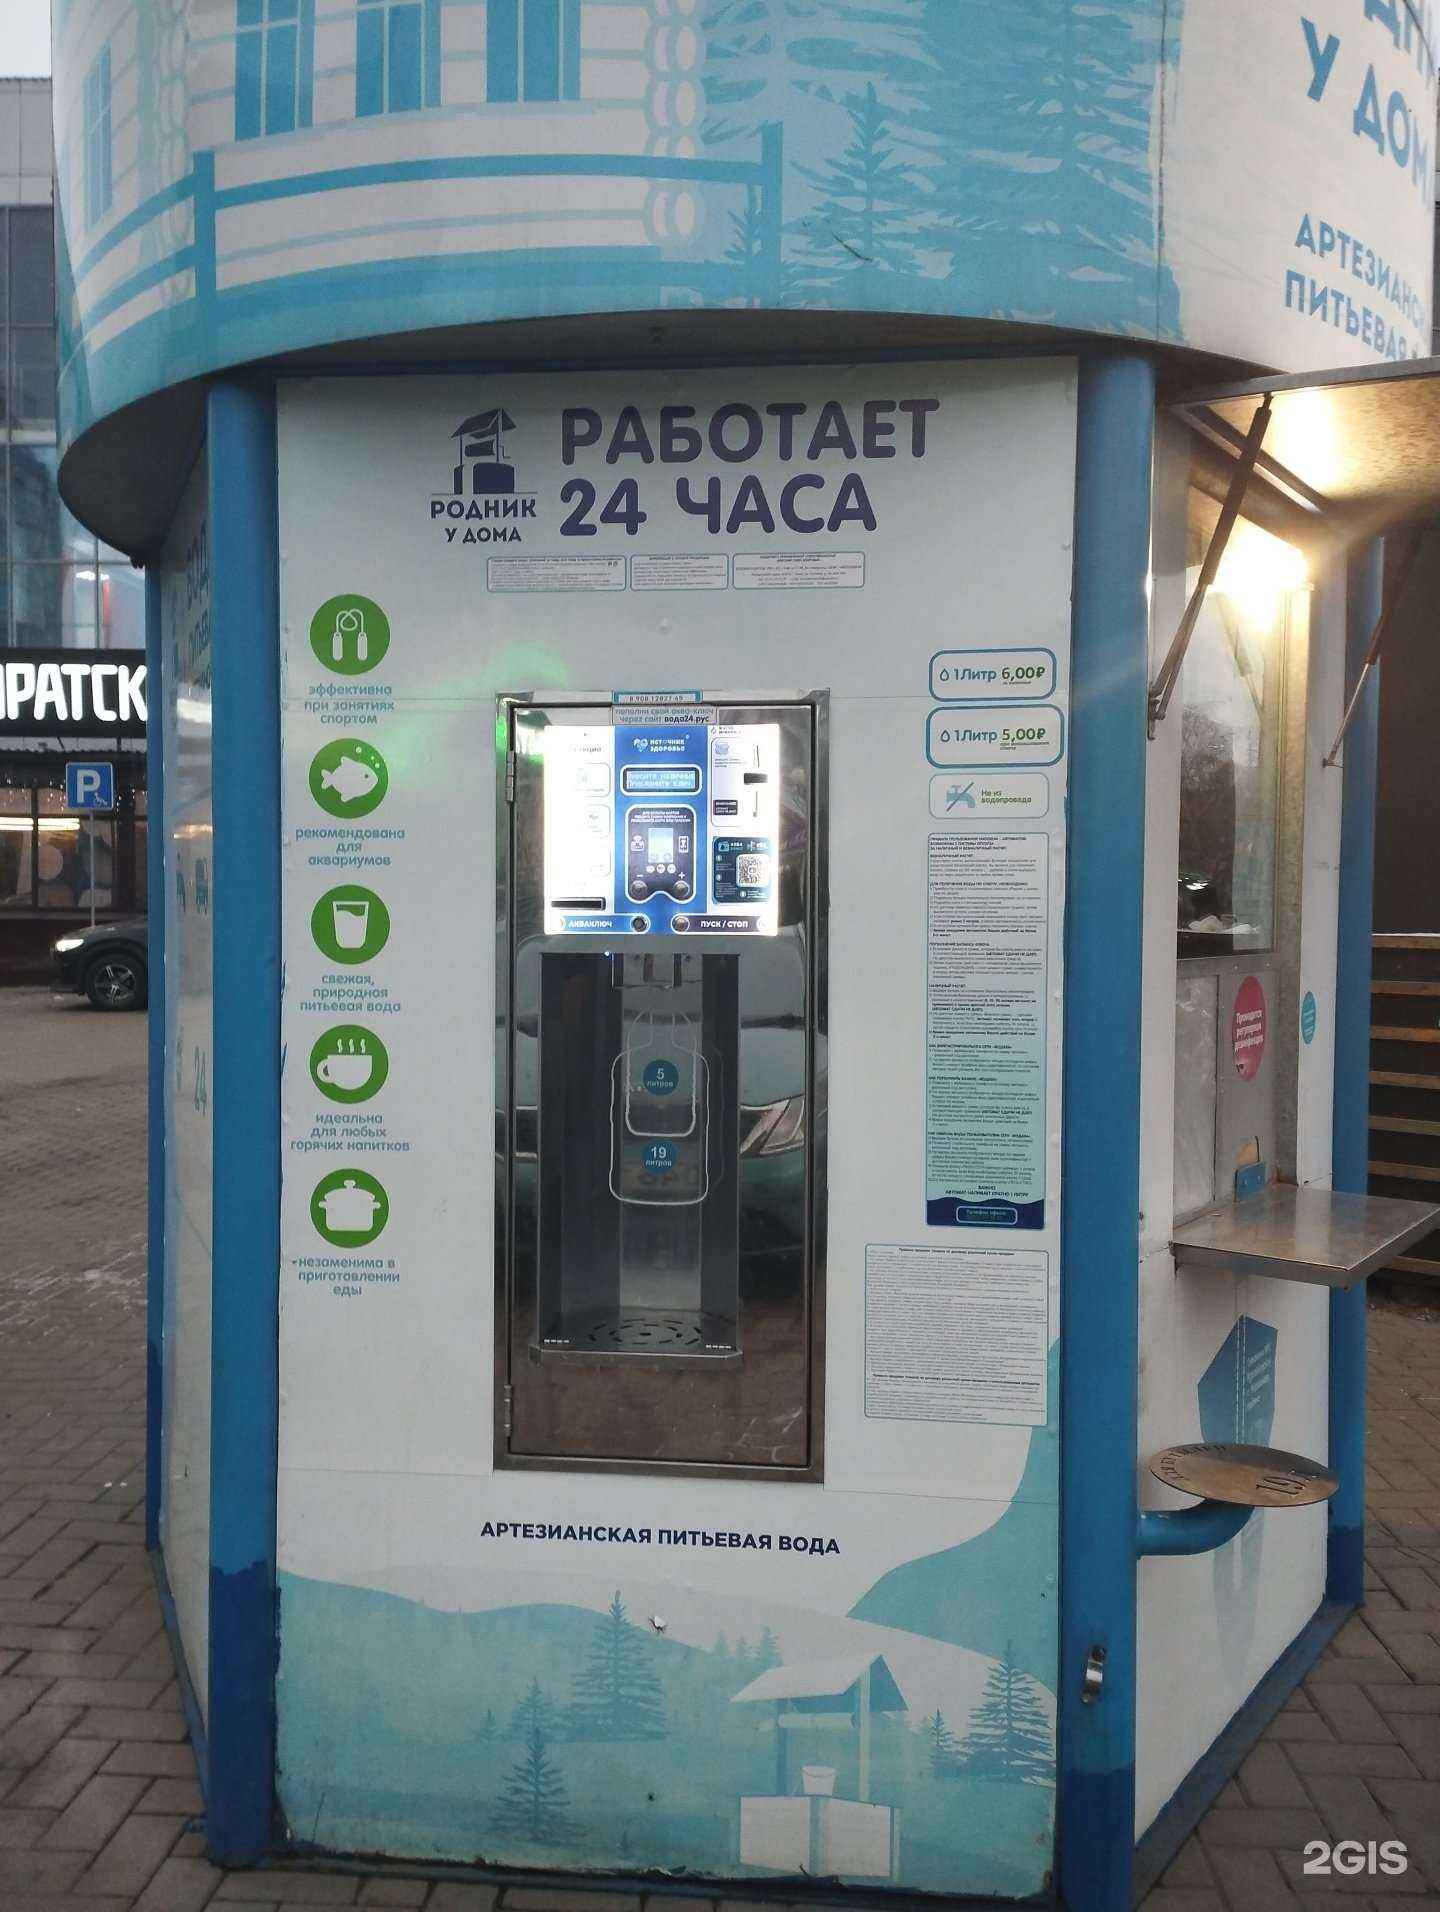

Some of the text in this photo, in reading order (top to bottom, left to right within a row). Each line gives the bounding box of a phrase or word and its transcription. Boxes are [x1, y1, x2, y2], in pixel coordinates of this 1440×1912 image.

[1300, 16, 1340, 102] У
[561, 399, 940, 466] РАБОТАЕТ
[430, 498, 537, 521] РОДНИК
[560, 472, 877, 536] 24 ЧАСА
[445, 526, 522, 545] У ДОМА
[0, 663, 148, 722] РАТСК
[308, 684, 393, 699] эффективна
[304, 701, 395, 713] при занятиях
[320, 714, 378, 727] спортом
[76, 769, 101, 804] P
[295, 827, 406, 842] рекомендована
[336, 841, 362, 854] для
[308, 855, 392, 869] аквариумов
[568, 920, 613, 928] АКВАКЛЮЧ
[700, 920, 722, 928] ПУСК
[727, 920, 749, 928] СТОП
[321, 973, 375, 986] свежая,
[312, 987, 388, 1001] природная
[300, 1001, 401, 1014] питьевая вода
[657, 1067, 665, 1080] 5
[315, 1113, 383, 1126] идеальна
[310, 1126, 386, 1140] для любых
[290, 1140, 410, 1154] горячих напитков
[651, 1146, 667, 1159] 19
[298, 1257, 395, 1269] незаменима в
[298, 1271, 401, 1284] приготовлении
[333, 1286, 362, 1298] еды
[480, 1521, 840, 1556] АРТЕЗИАНСКАЯ ПИТЬЕВАЯ ВОДА
